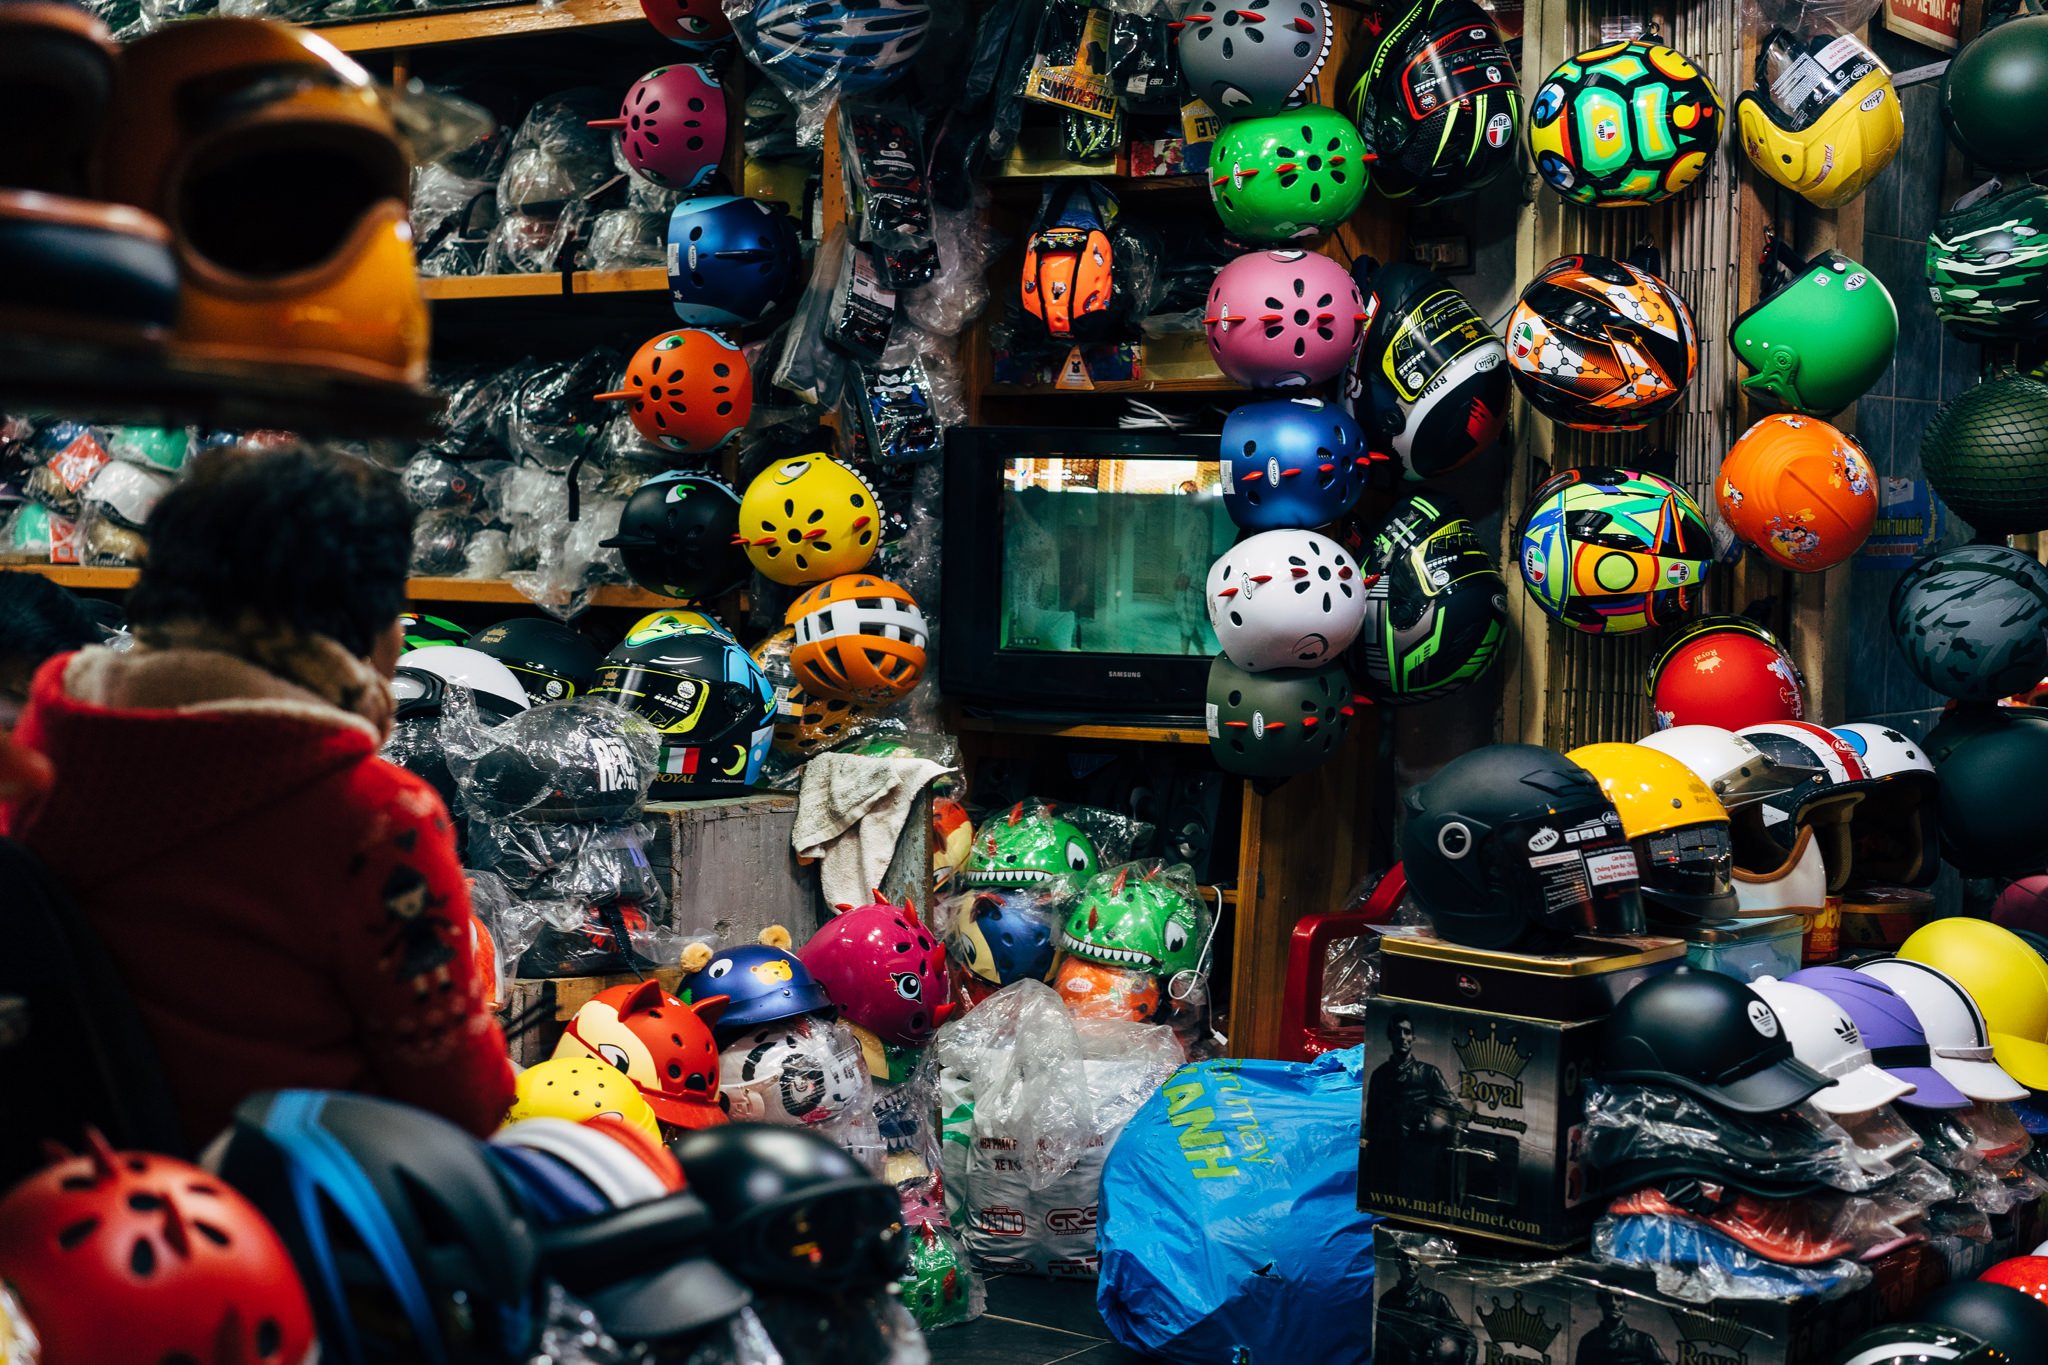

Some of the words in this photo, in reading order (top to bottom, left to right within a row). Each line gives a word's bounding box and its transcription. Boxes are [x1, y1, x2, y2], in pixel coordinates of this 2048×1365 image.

[1848, 273, 1866, 288] VIA
[1531, 831, 1558, 849] NEW!
[1459, 1071, 1524, 1110] Royal
[1369, 1190, 1542, 1236] www.mafahelmet.com
